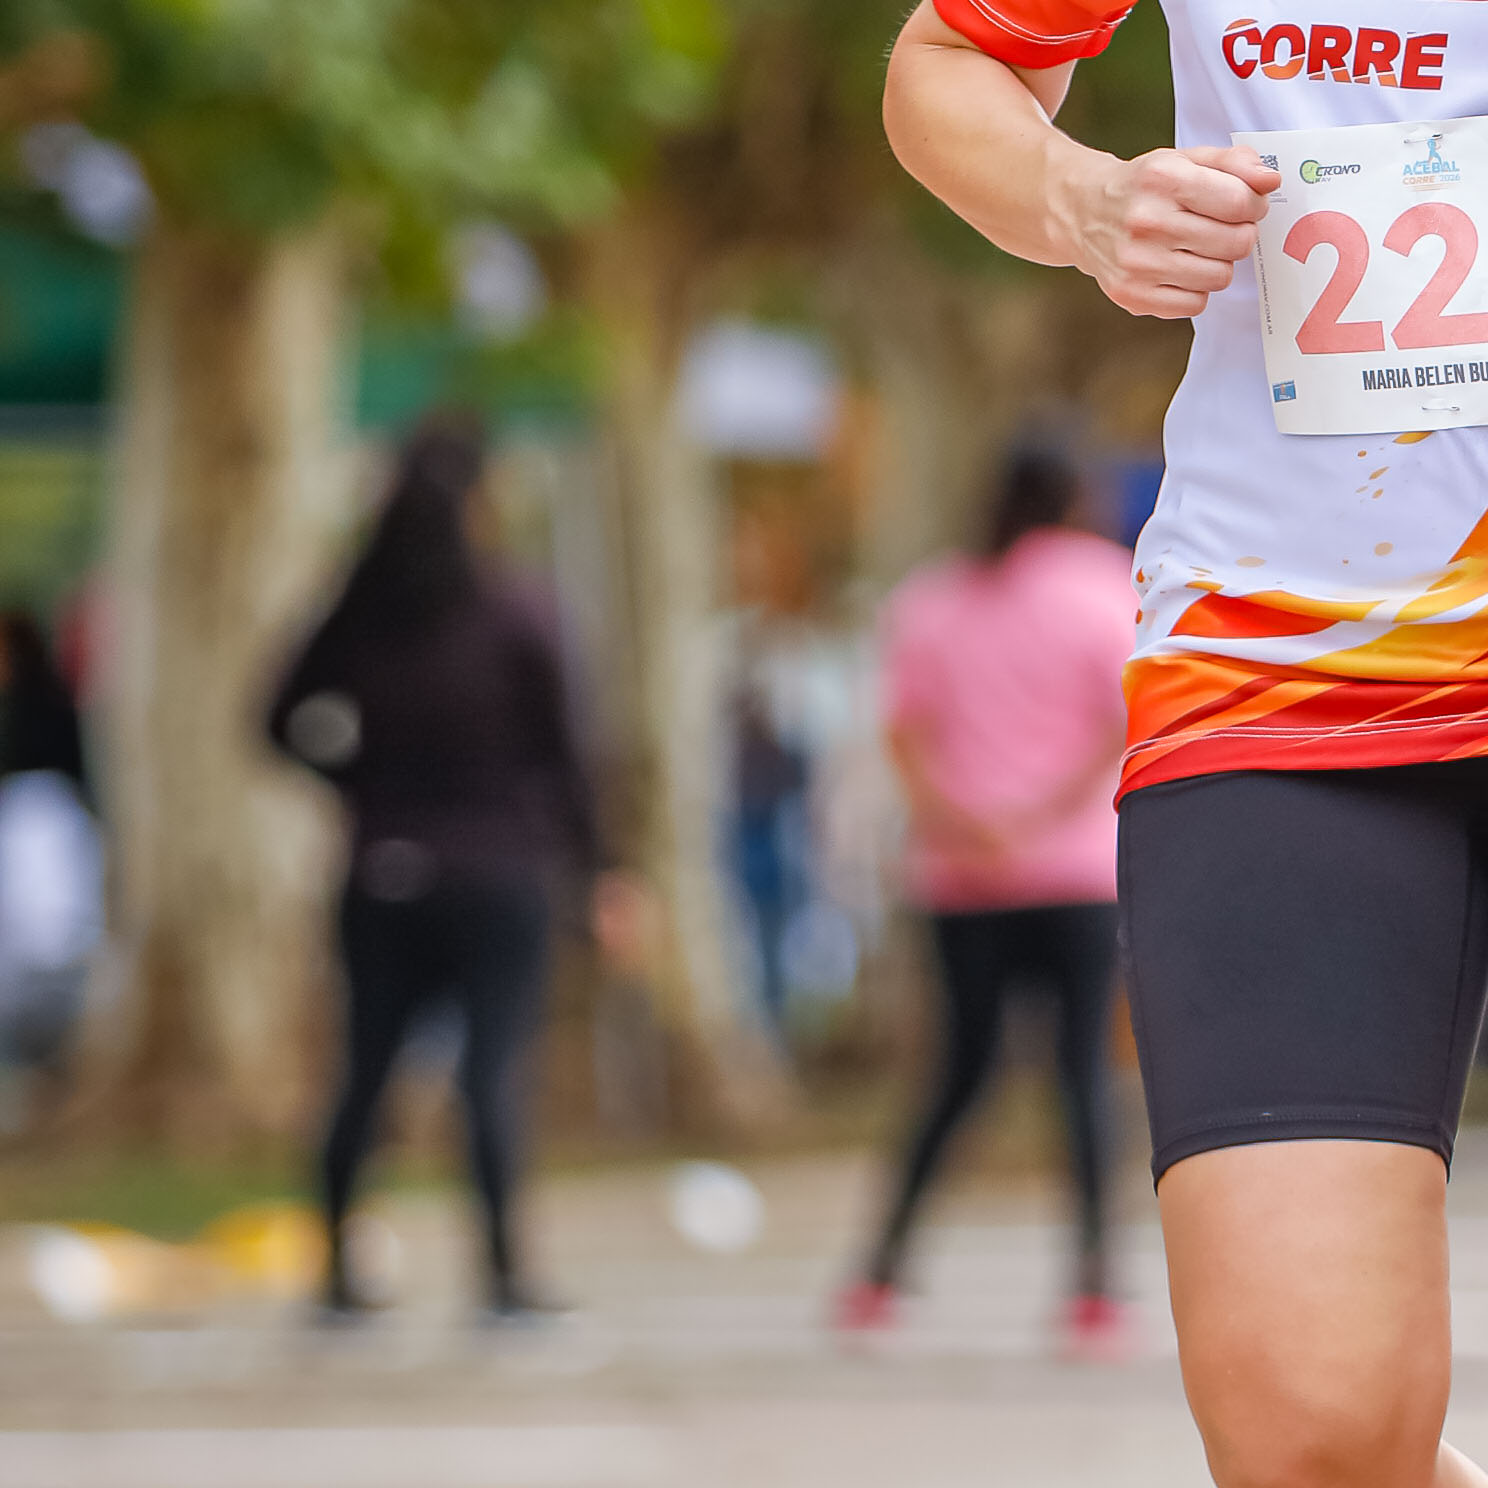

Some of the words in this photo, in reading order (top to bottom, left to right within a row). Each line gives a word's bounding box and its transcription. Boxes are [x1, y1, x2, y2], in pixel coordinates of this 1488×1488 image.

[1222, 19, 1449, 91] CORRE
[1402, 160, 1461, 176] ACEBAL
[1402, 175, 1436, 186] CORRE
[1440, 173, 1461, 183] 2026
[1362, 368, 1412, 390] MARIA
[1415, 363, 1466, 388] BELEN
